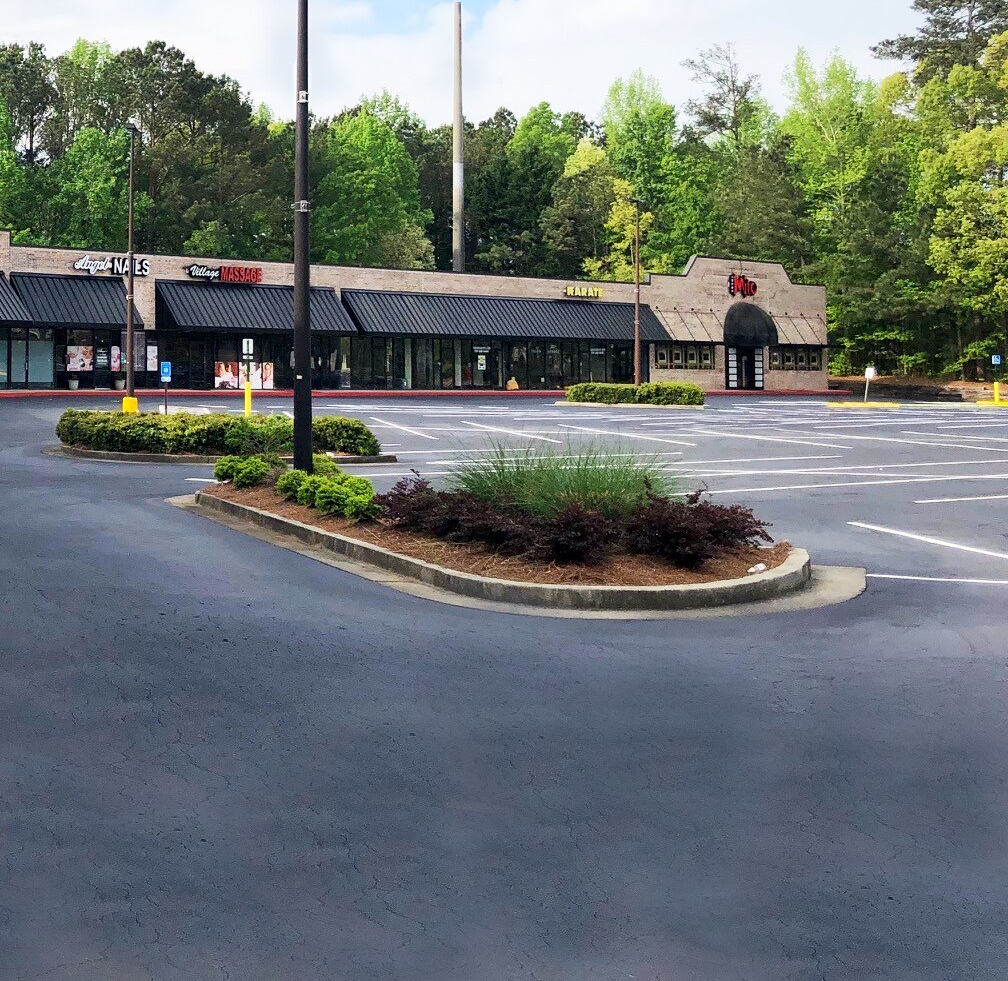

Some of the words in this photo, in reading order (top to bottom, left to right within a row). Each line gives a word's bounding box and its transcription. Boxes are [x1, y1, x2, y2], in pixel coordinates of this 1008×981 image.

[74, 255, 112, 275] Angel
[190, 265, 220, 280] Village
[221, 266, 262, 283] MASSAGE
[566, 286, 603, 297] KARATE
